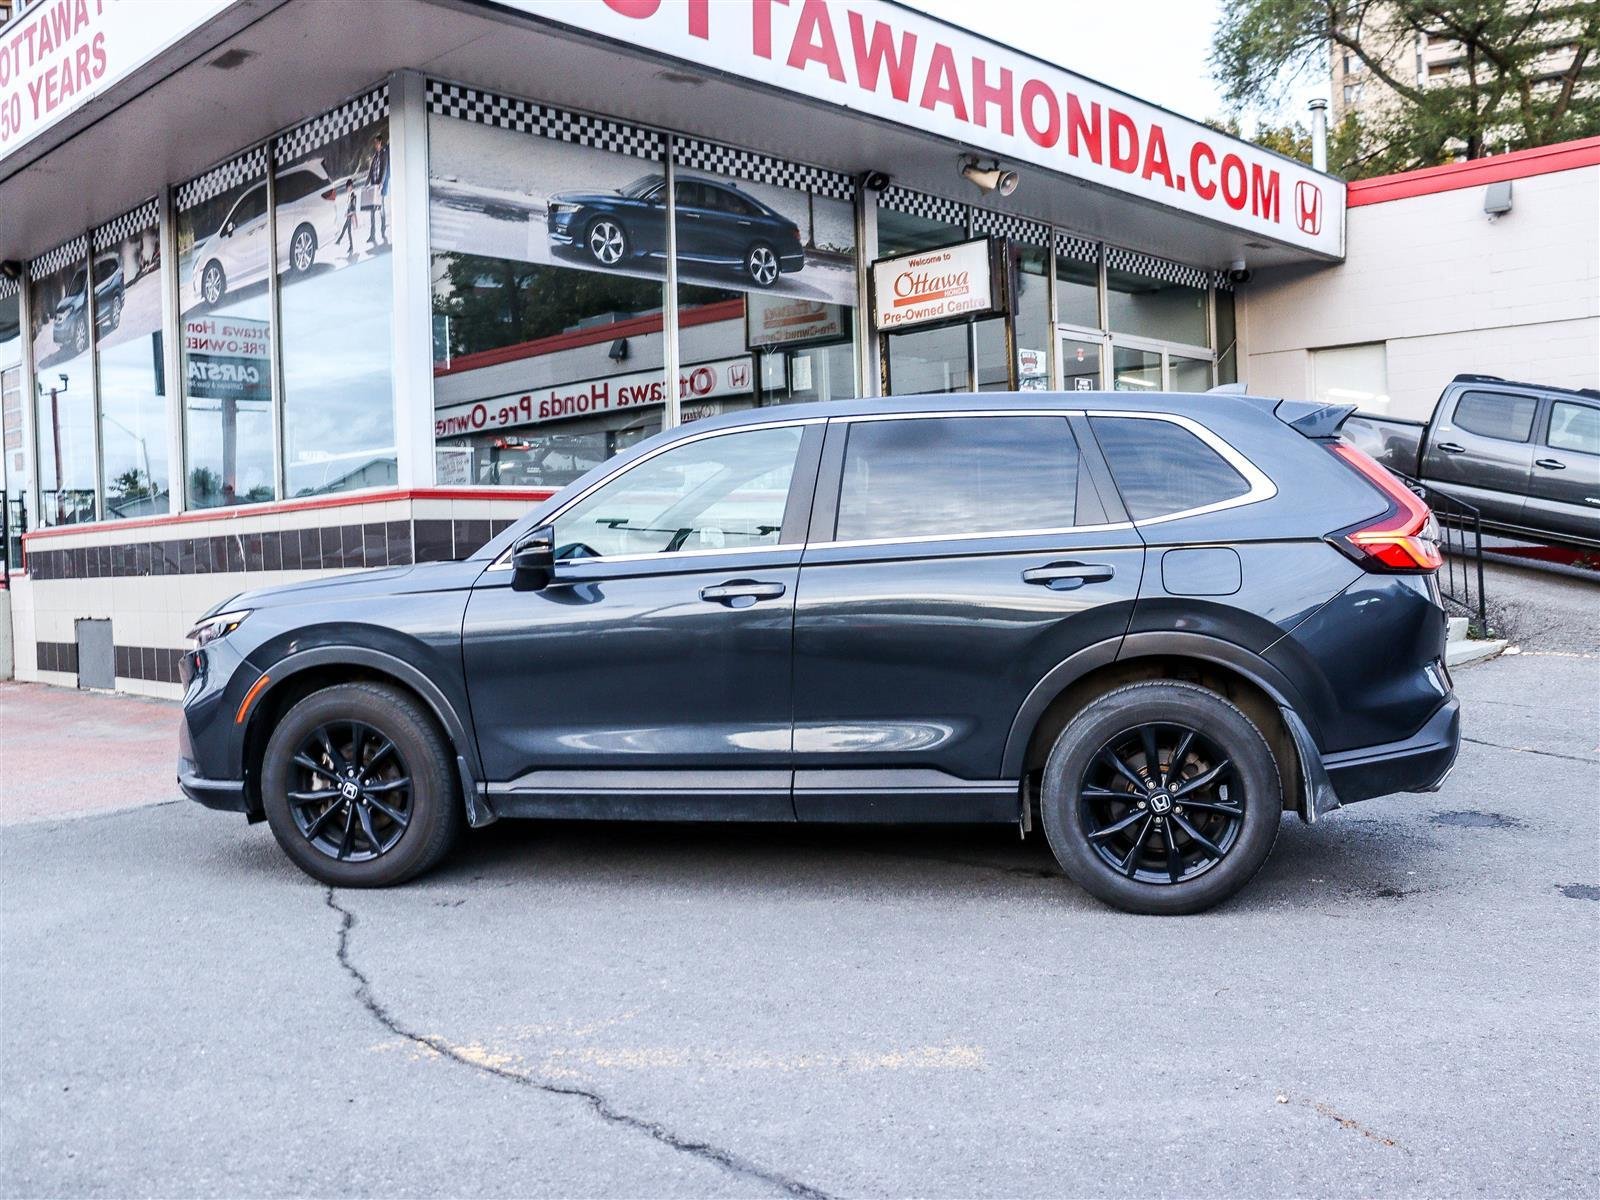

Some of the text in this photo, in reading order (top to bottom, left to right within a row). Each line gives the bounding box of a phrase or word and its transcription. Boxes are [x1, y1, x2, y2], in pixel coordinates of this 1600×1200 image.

[0, 0, 90, 88] OTTAWA
[1, 31, 108, 142] 50 YEARS
[604, 0, 1280, 224] TAWAHONDA.COM
[893, 270, 969, 298] Ottawa
[908, 253, 951, 268] Welcome to
[883, 297, 986, 325] Pre-Owned Centre
